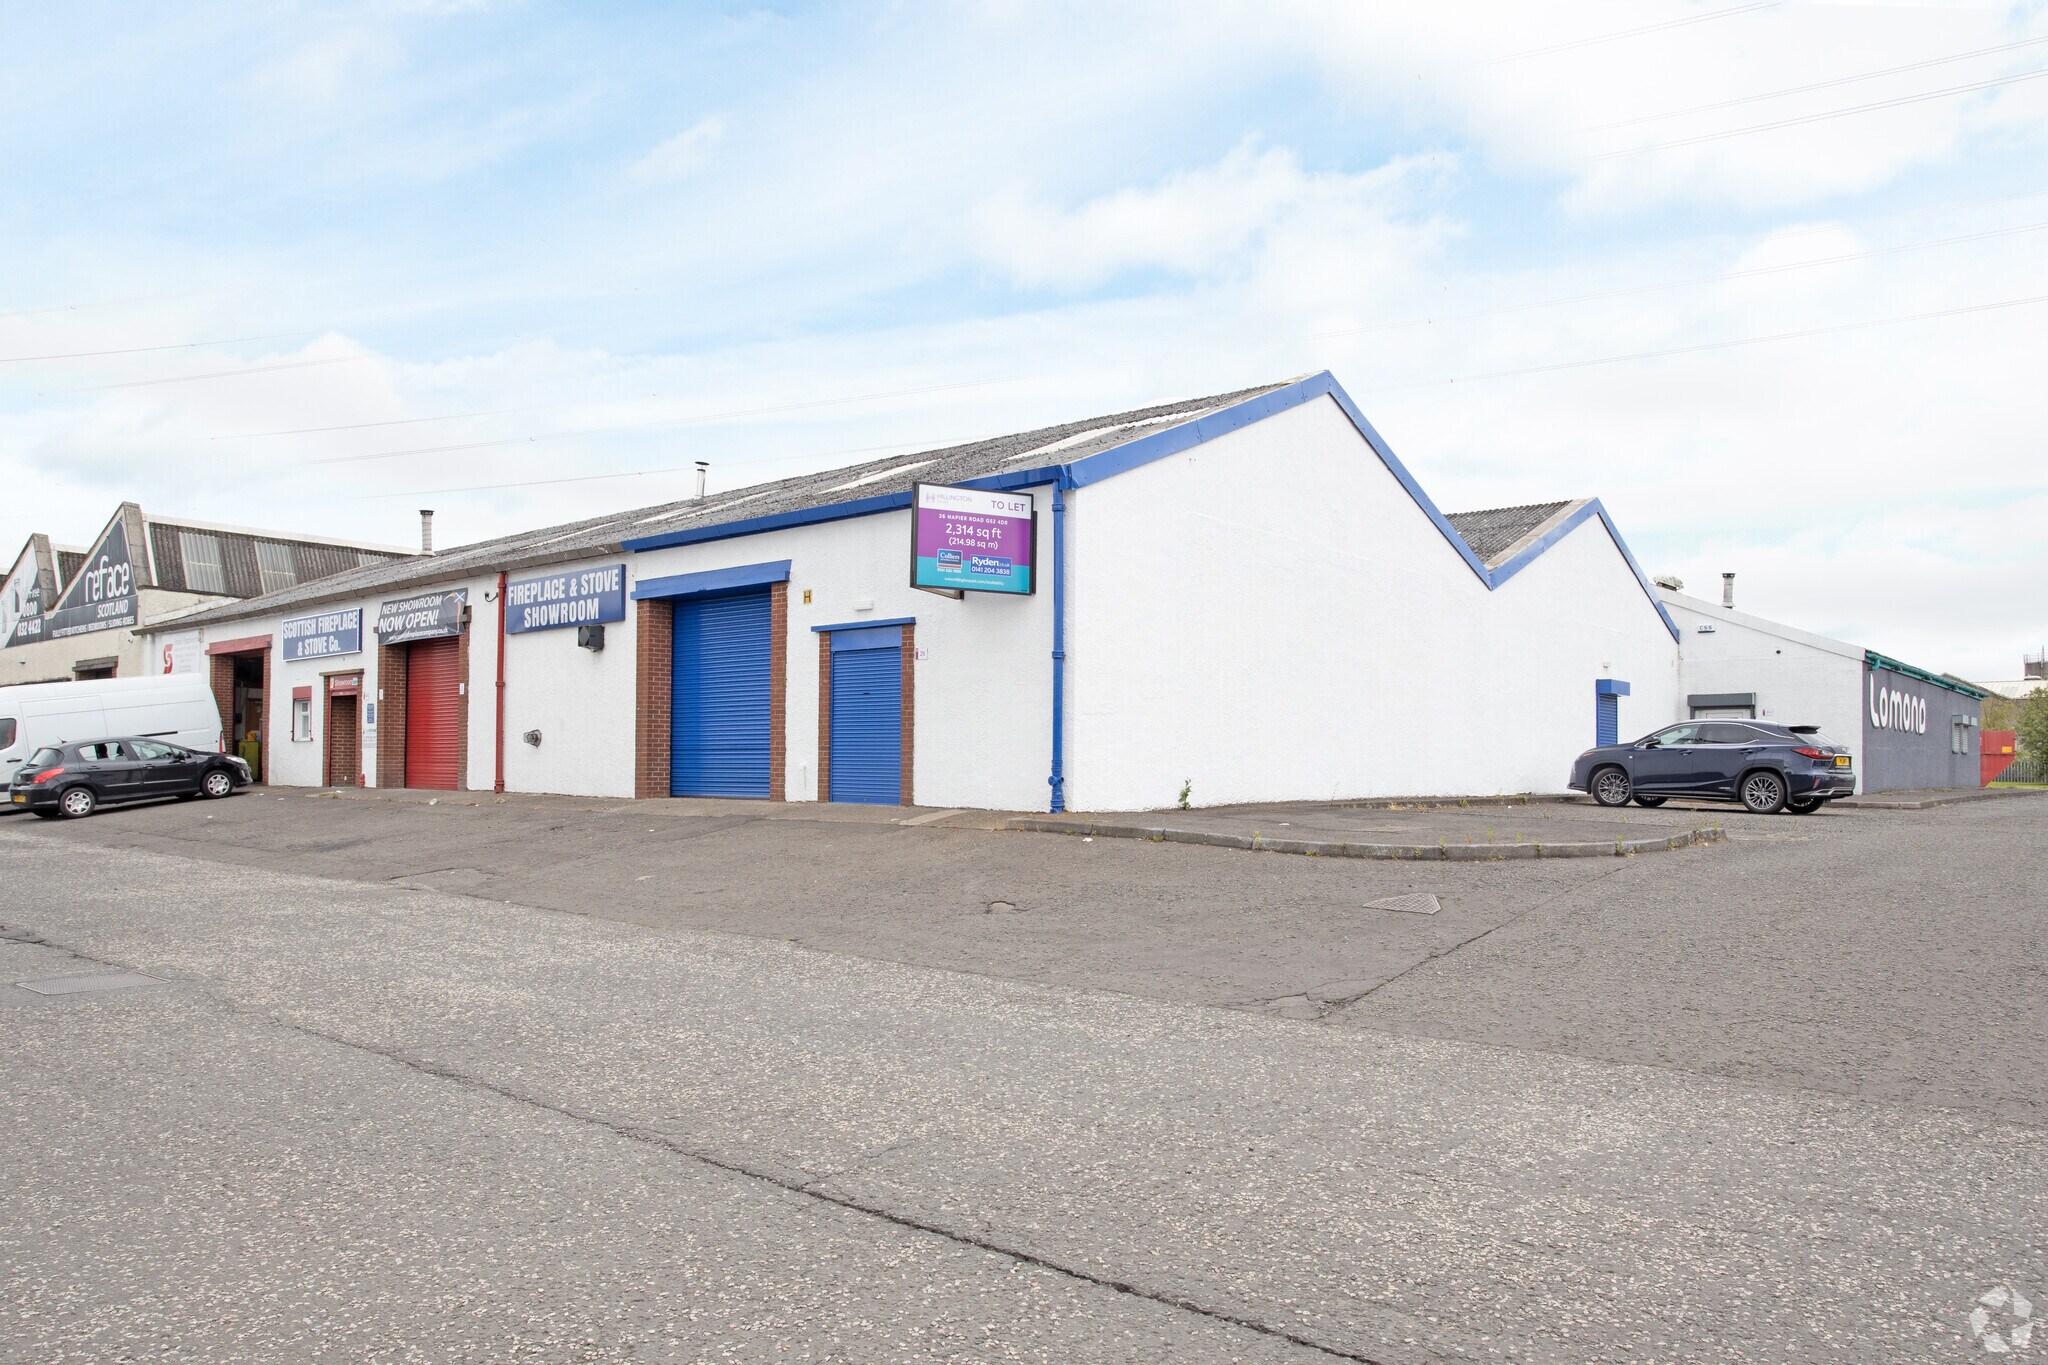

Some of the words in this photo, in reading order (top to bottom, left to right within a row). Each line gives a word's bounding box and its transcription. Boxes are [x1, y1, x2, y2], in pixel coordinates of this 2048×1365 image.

[991, 500, 1004, 509] TO
[1008, 502, 1025, 511] LET
[945, 523, 974, 536] 2,314
[976, 528, 989, 540] sq
[991, 527, 1002, 539] ft
[948, 536, 976, 547] (214.98
[977, 541, 986, 549] sq
[987, 541, 998, 550] m)
[85, 555, 129, 602] reface
[508, 577, 566, 606] FIREPLACE
[569, 578, 578, 597] &
[581, 569, 619, 596] STOVE
[97, 600, 129, 618] SCOTLAND
[381, 603, 398, 614] NEW
[399, 595, 442, 612] SHOWROOM
[524, 597, 600, 628] SHOWROOM
[283, 618, 317, 639] SCOTTISH
[318, 612, 358, 633] FIREPLACE
[379, 615, 404, 633] NOW
[405, 609, 440, 629] OPEN!
[297, 642, 303, 656] &
[304, 637, 328, 656] STOVE
[328, 637, 341, 652] Co.
